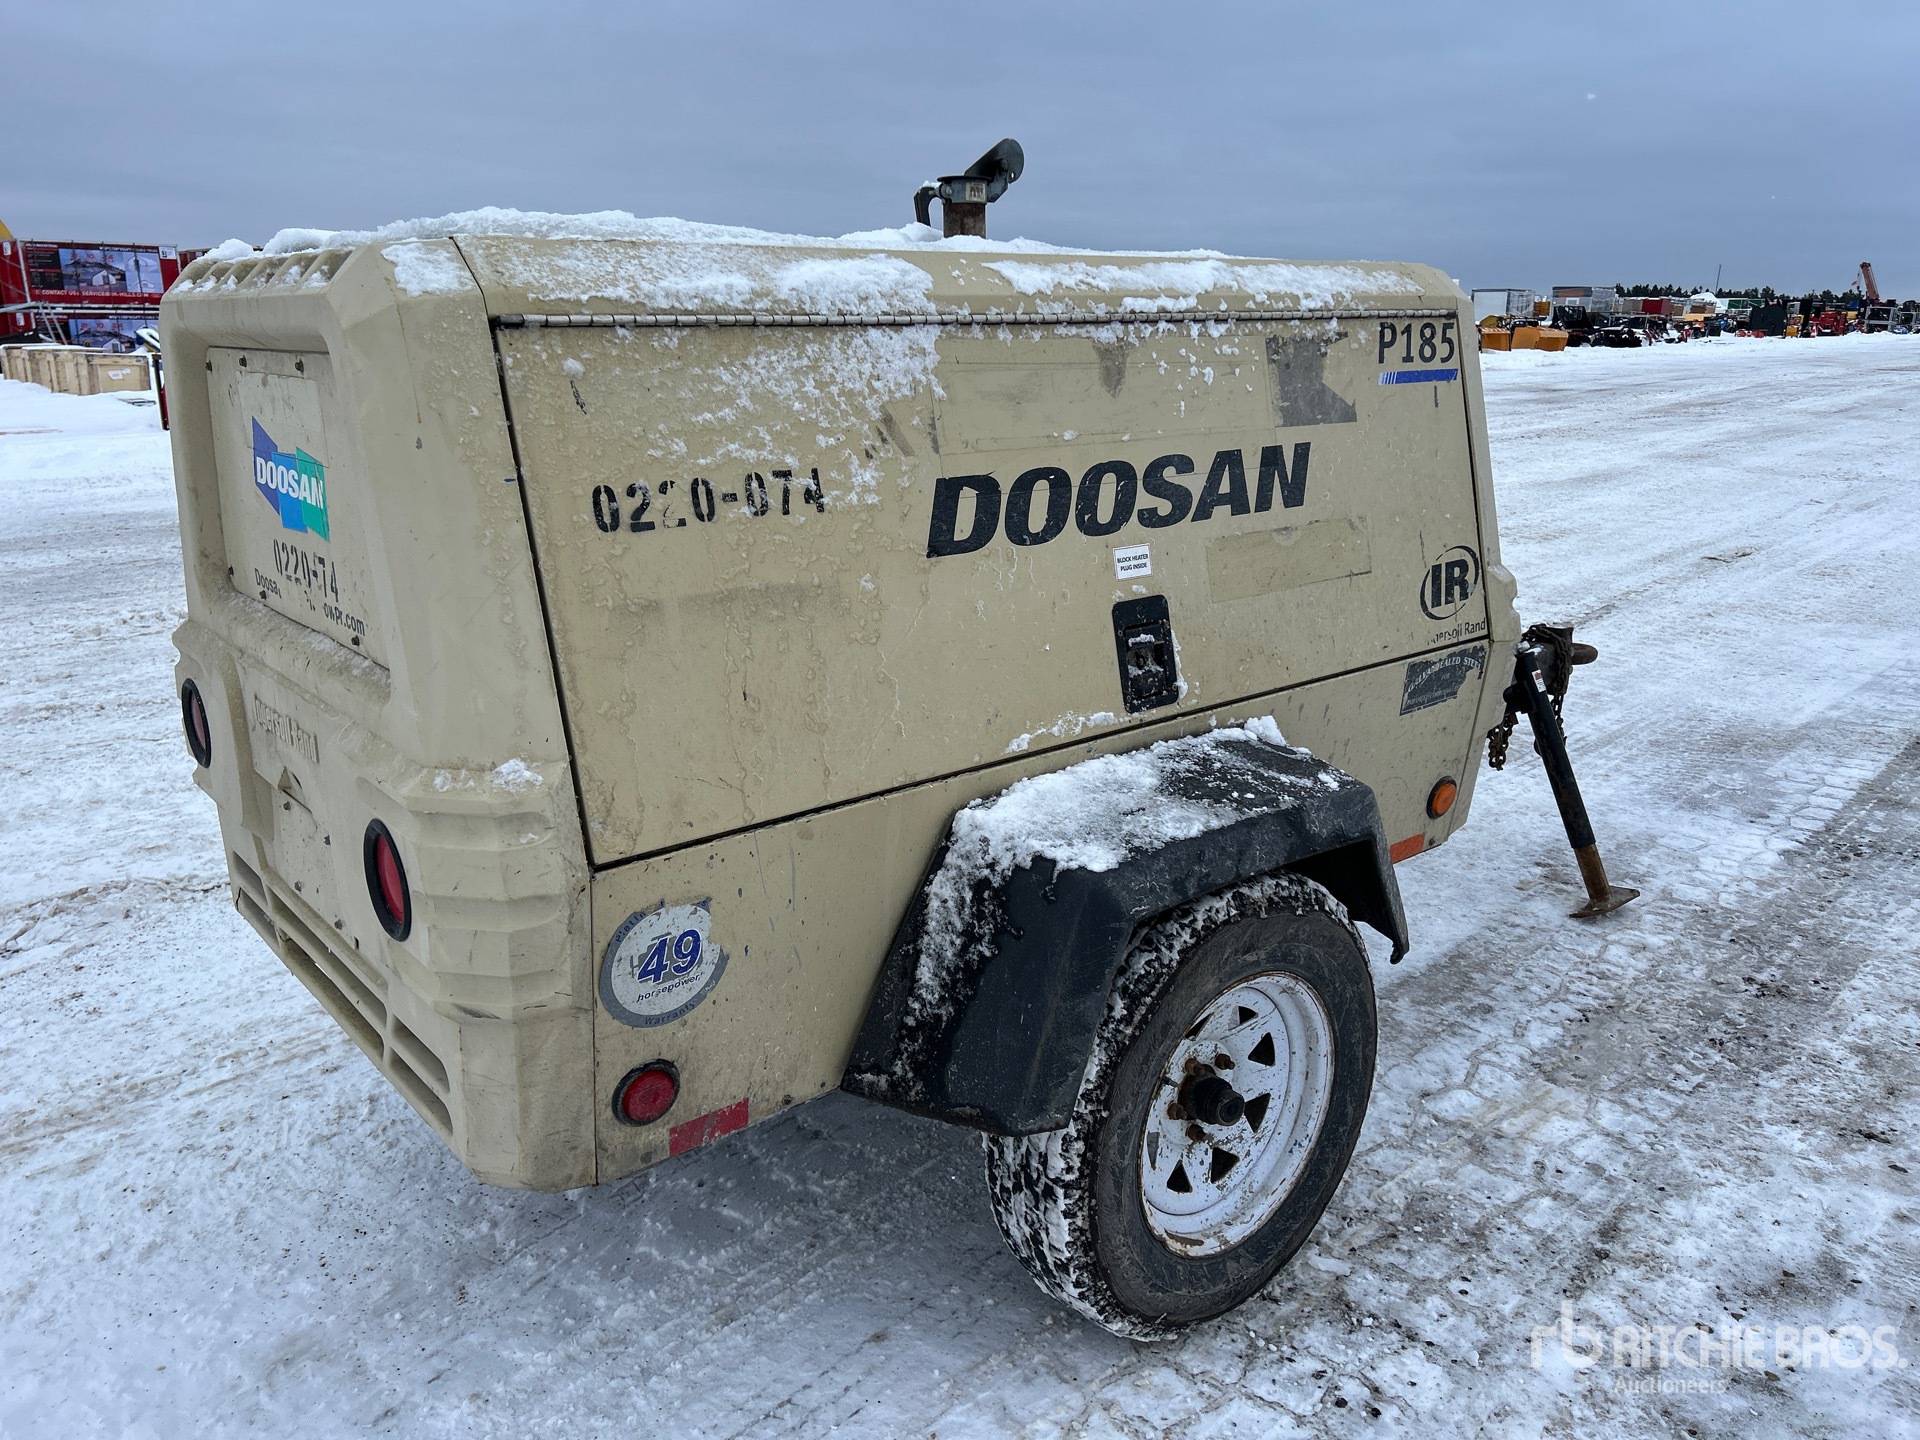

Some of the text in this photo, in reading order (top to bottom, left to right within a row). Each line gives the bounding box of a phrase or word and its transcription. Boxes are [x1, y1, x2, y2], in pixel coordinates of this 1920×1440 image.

[1378, 322, 1455, 364] P185
[256, 456, 323, 509] DOOSAN
[927, 442, 1311, 558] DOOSAN
[1431, 559, 1469, 609] IR
[1464, 617, 1486, 636] Rand
[637, 929, 702, 983] 49
[637, 974, 700, 1003] horsepower
[644, 1003, 696, 1026] Warranty
